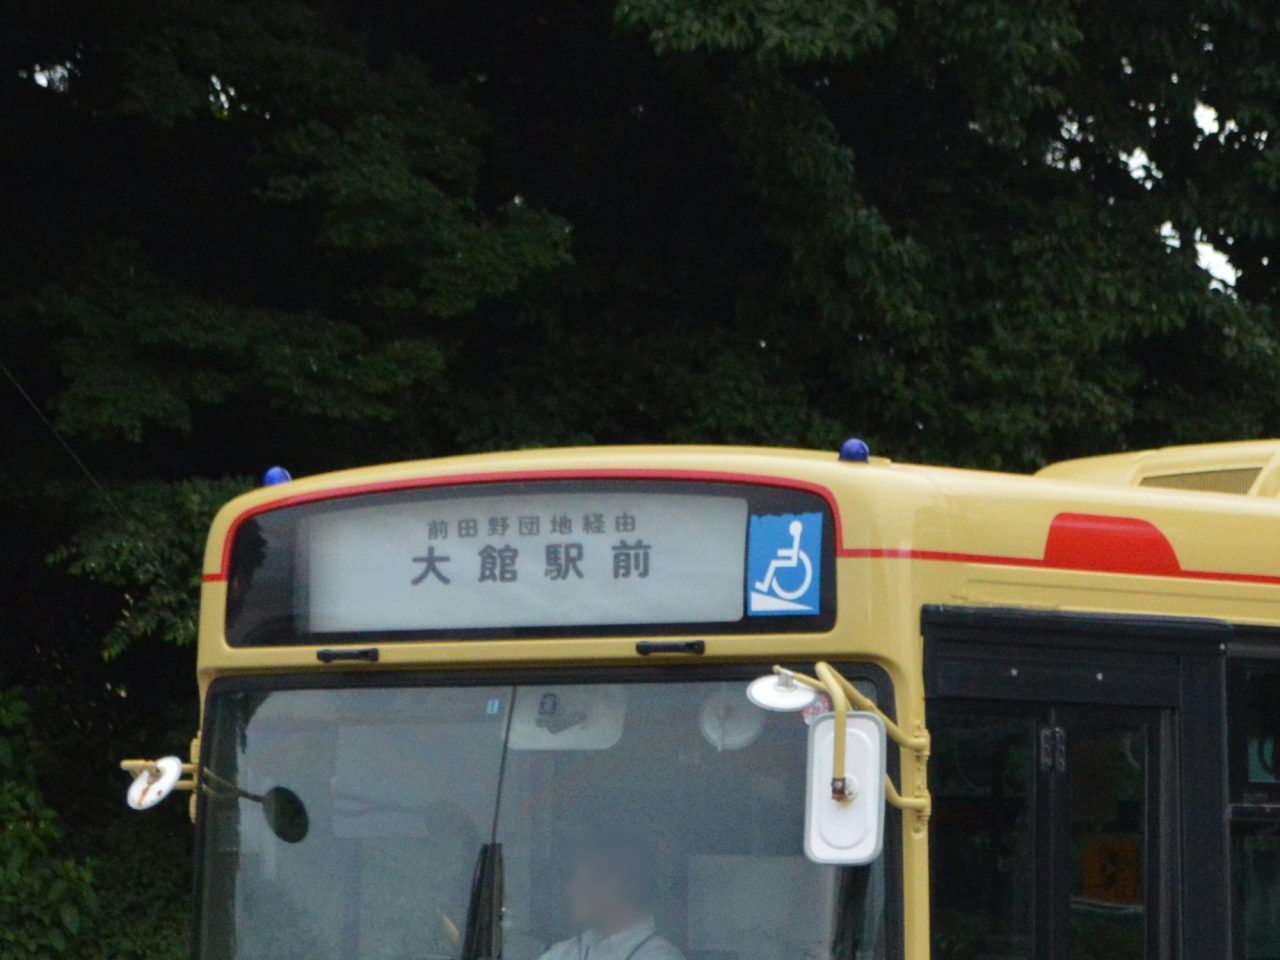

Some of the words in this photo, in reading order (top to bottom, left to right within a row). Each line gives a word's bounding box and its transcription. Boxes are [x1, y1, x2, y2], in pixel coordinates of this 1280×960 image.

[427, 512, 637, 540] 前田野団地経由
[411, 540, 652, 586] 大館駅前
